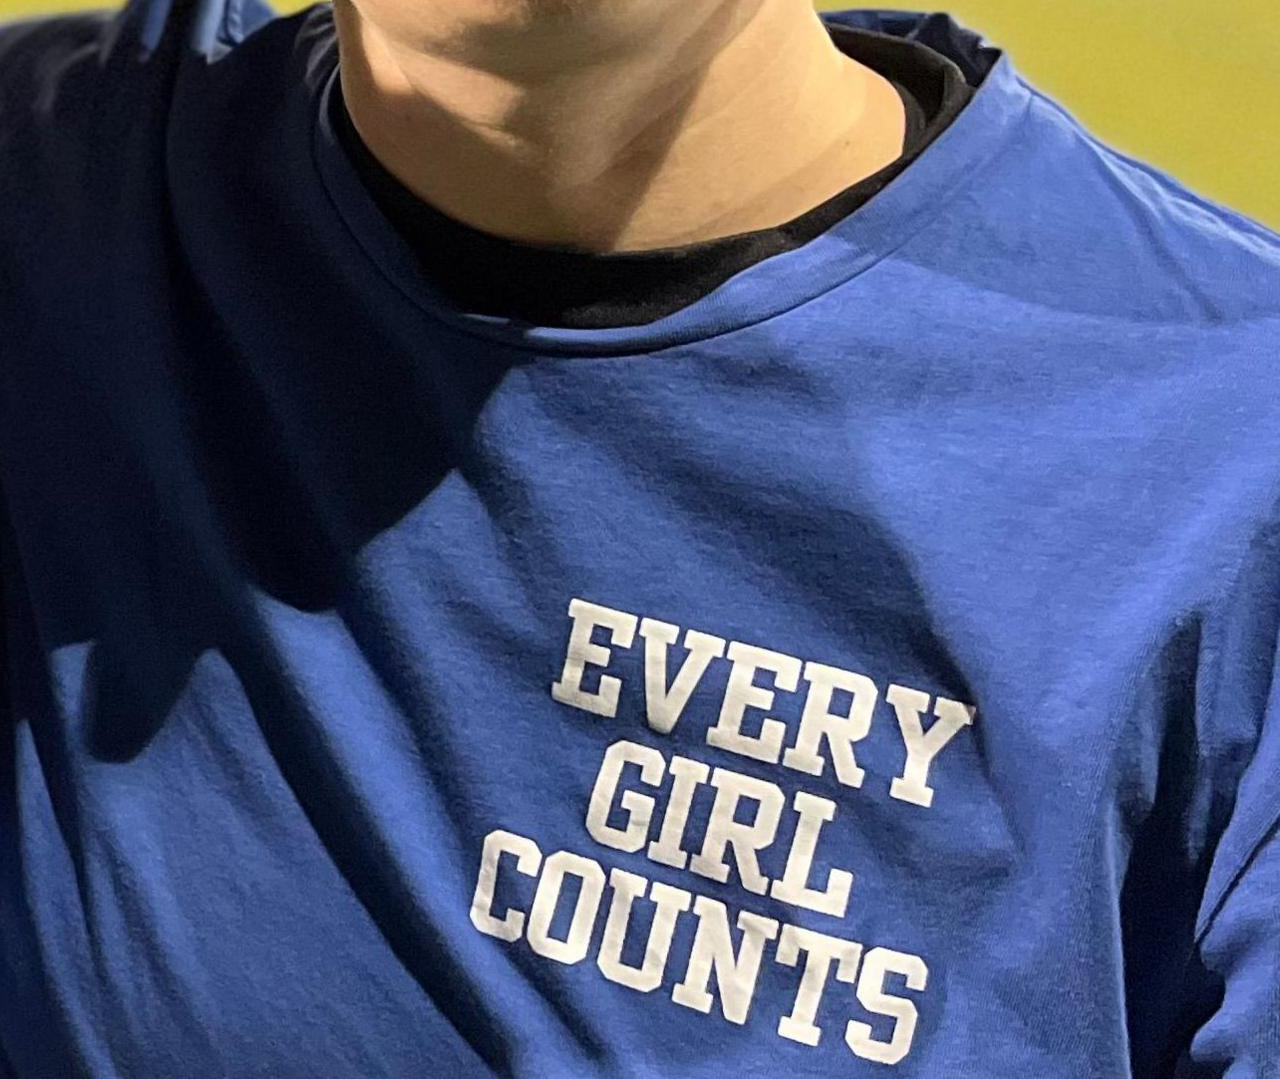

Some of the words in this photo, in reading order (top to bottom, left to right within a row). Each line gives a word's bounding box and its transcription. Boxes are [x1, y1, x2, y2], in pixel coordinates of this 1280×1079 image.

[550, 597, 977, 808] EVERY
[585, 739, 854, 919] GIRL
[469, 829, 929, 1066] COUNTS
